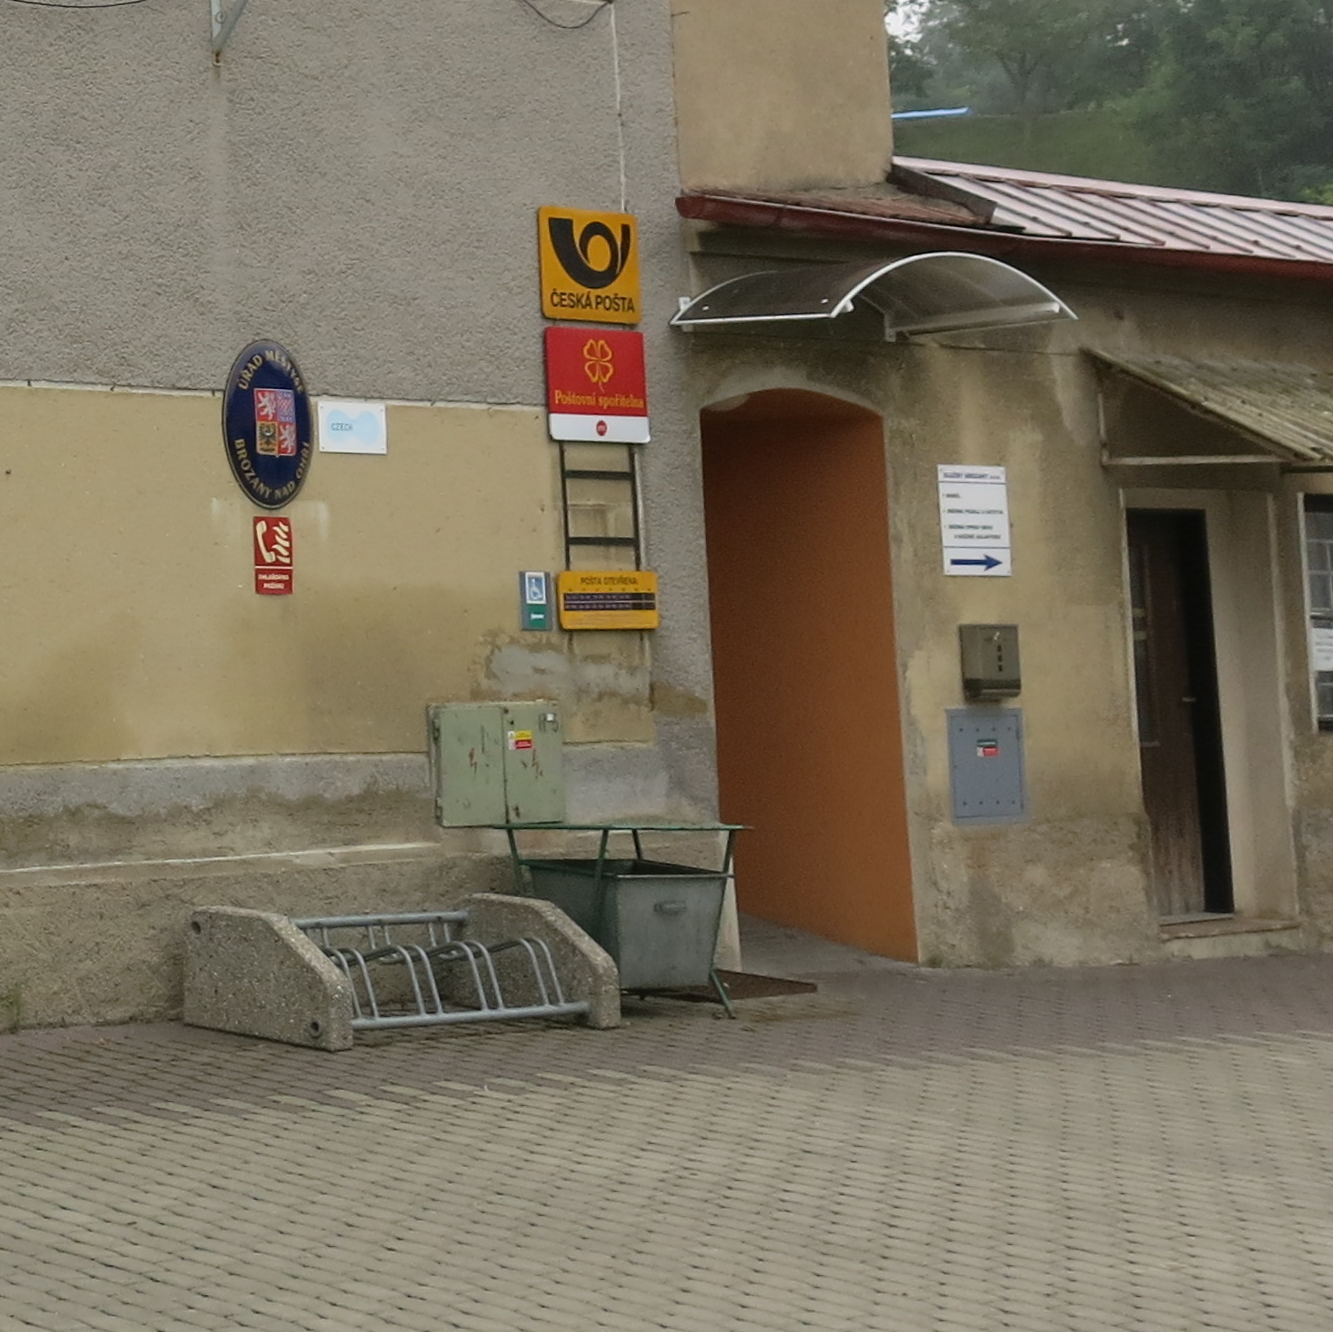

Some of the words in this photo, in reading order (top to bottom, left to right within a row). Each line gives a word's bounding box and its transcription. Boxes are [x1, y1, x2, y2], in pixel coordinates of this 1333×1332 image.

[550, 288, 592, 309] ČESKÁ
[595, 293, 635, 312] POŠTA
[555, 389, 596, 405] Poštovní
[598, 392, 644, 409] spořitelna
[274, 480, 296, 500] NAD
